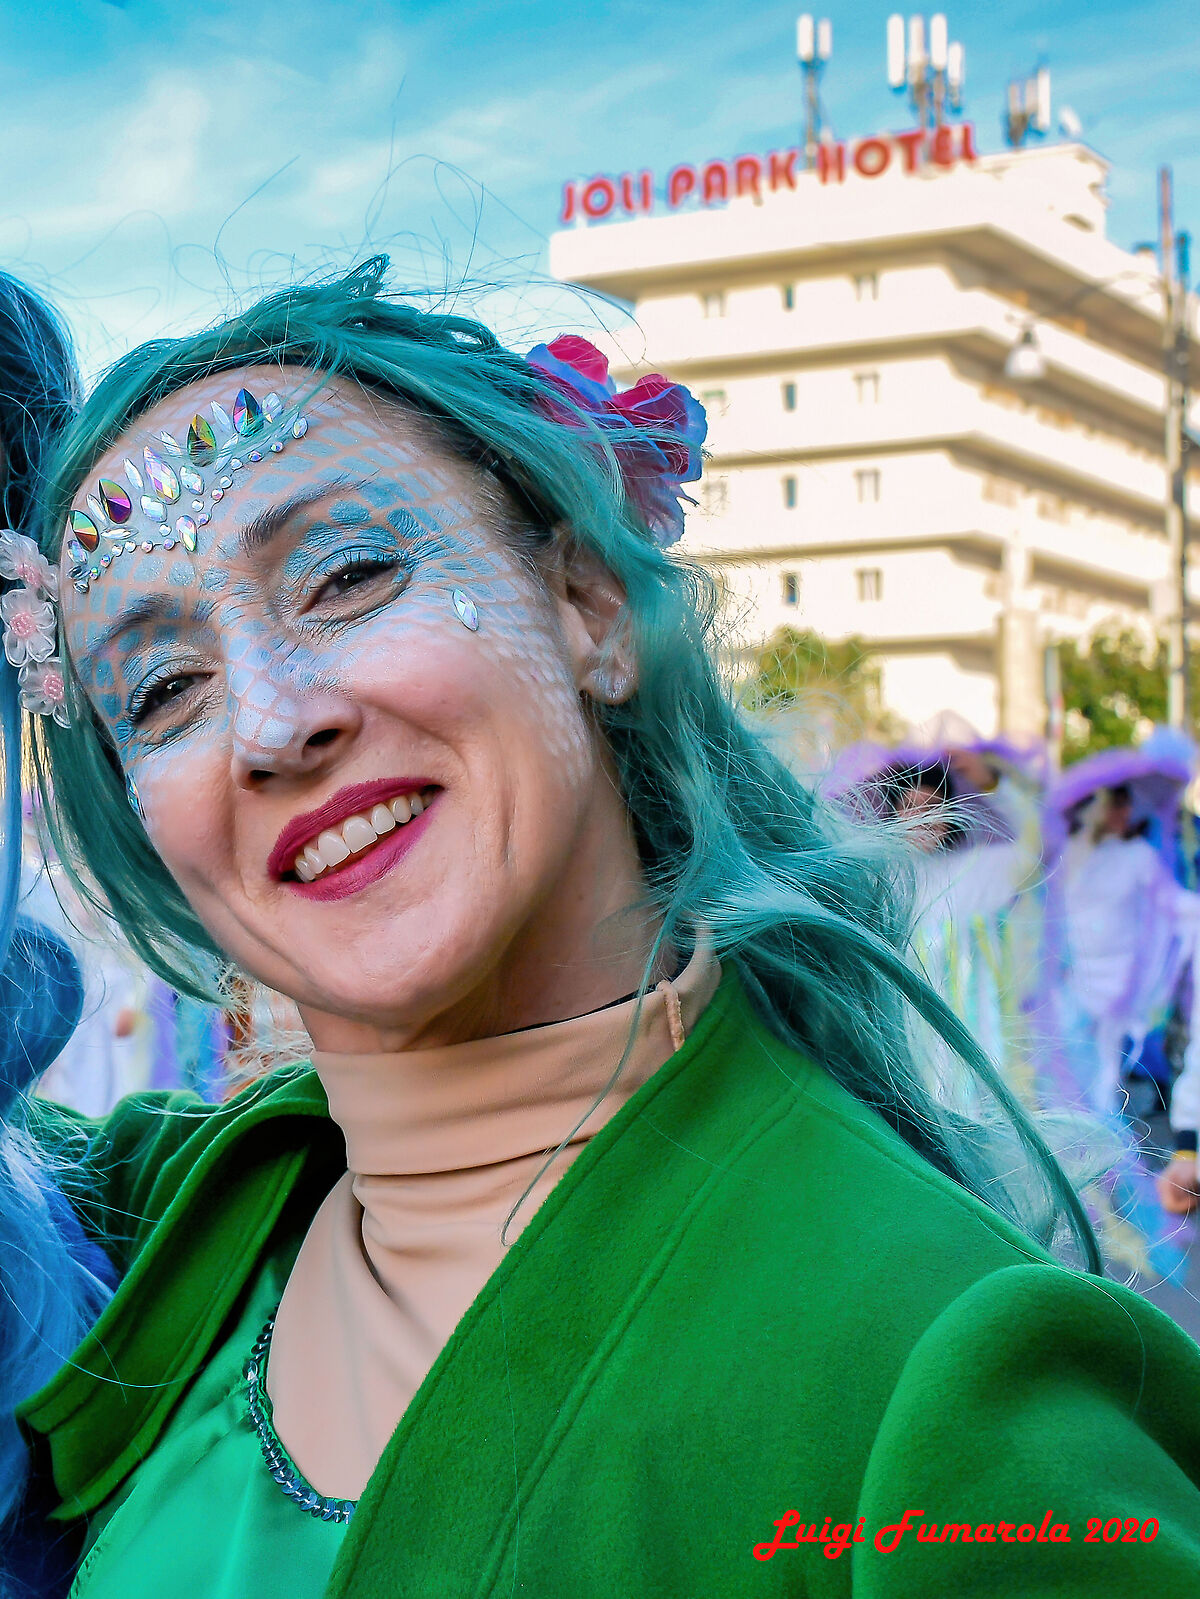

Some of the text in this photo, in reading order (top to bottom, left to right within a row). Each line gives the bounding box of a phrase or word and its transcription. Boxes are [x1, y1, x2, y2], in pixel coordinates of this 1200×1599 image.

[561, 123, 978, 222] JOLI PARK HOTEL
